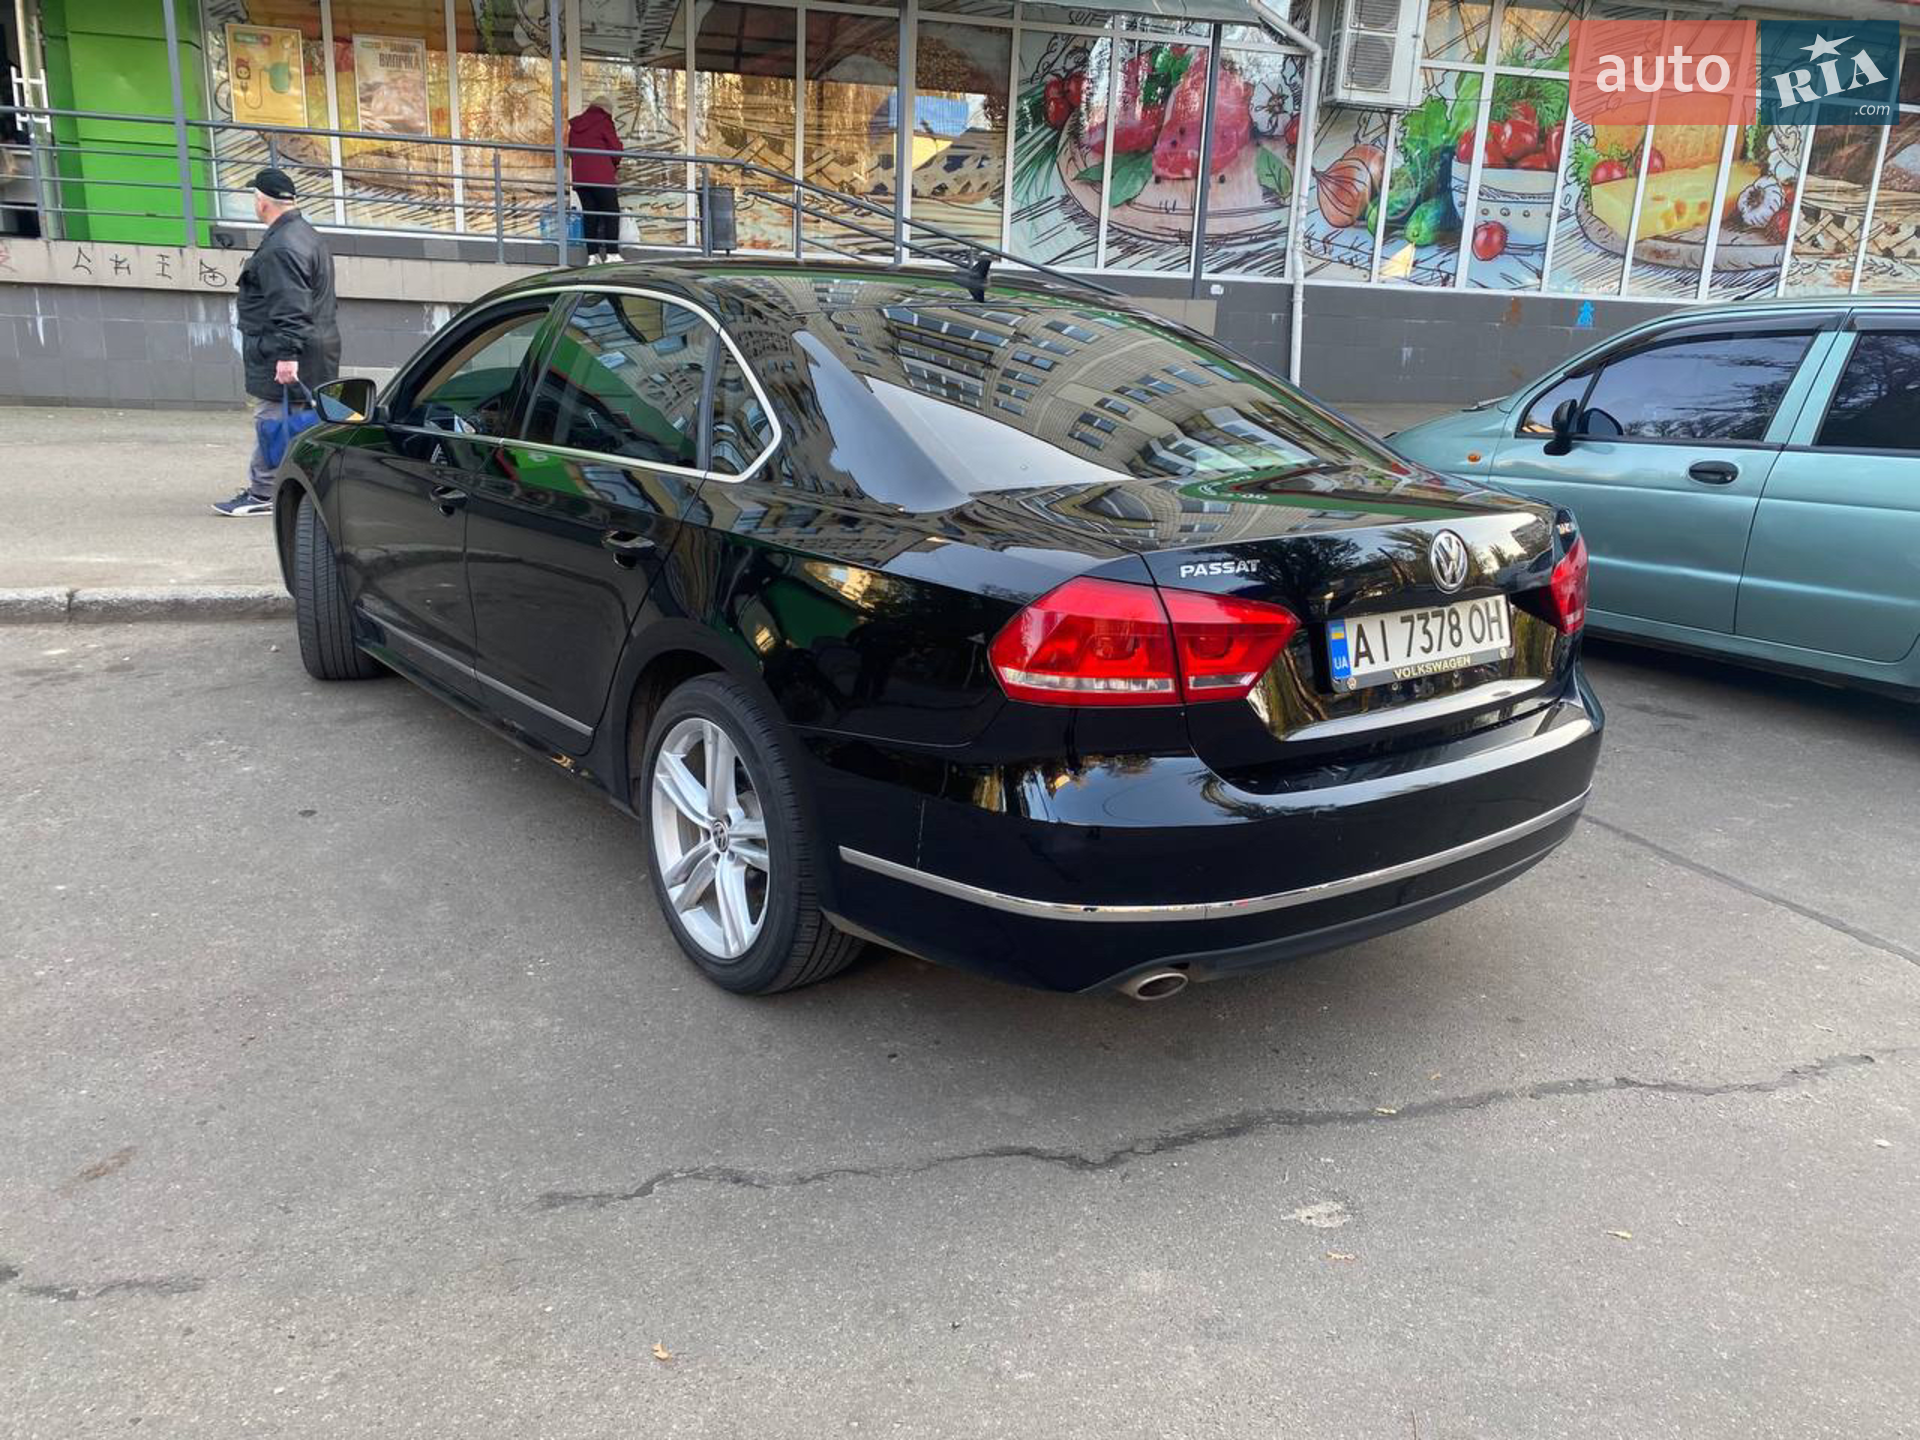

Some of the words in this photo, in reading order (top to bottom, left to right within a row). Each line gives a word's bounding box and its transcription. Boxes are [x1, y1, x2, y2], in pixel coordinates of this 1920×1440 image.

[1179, 559, 1261, 579] PASSAT
[1400, 608, 1463, 658] 7378
[1468, 601, 1504, 644] OH
[1333, 657, 1349, 670] UA
[1393, 655, 1472, 680] VOLKSWAGEN
